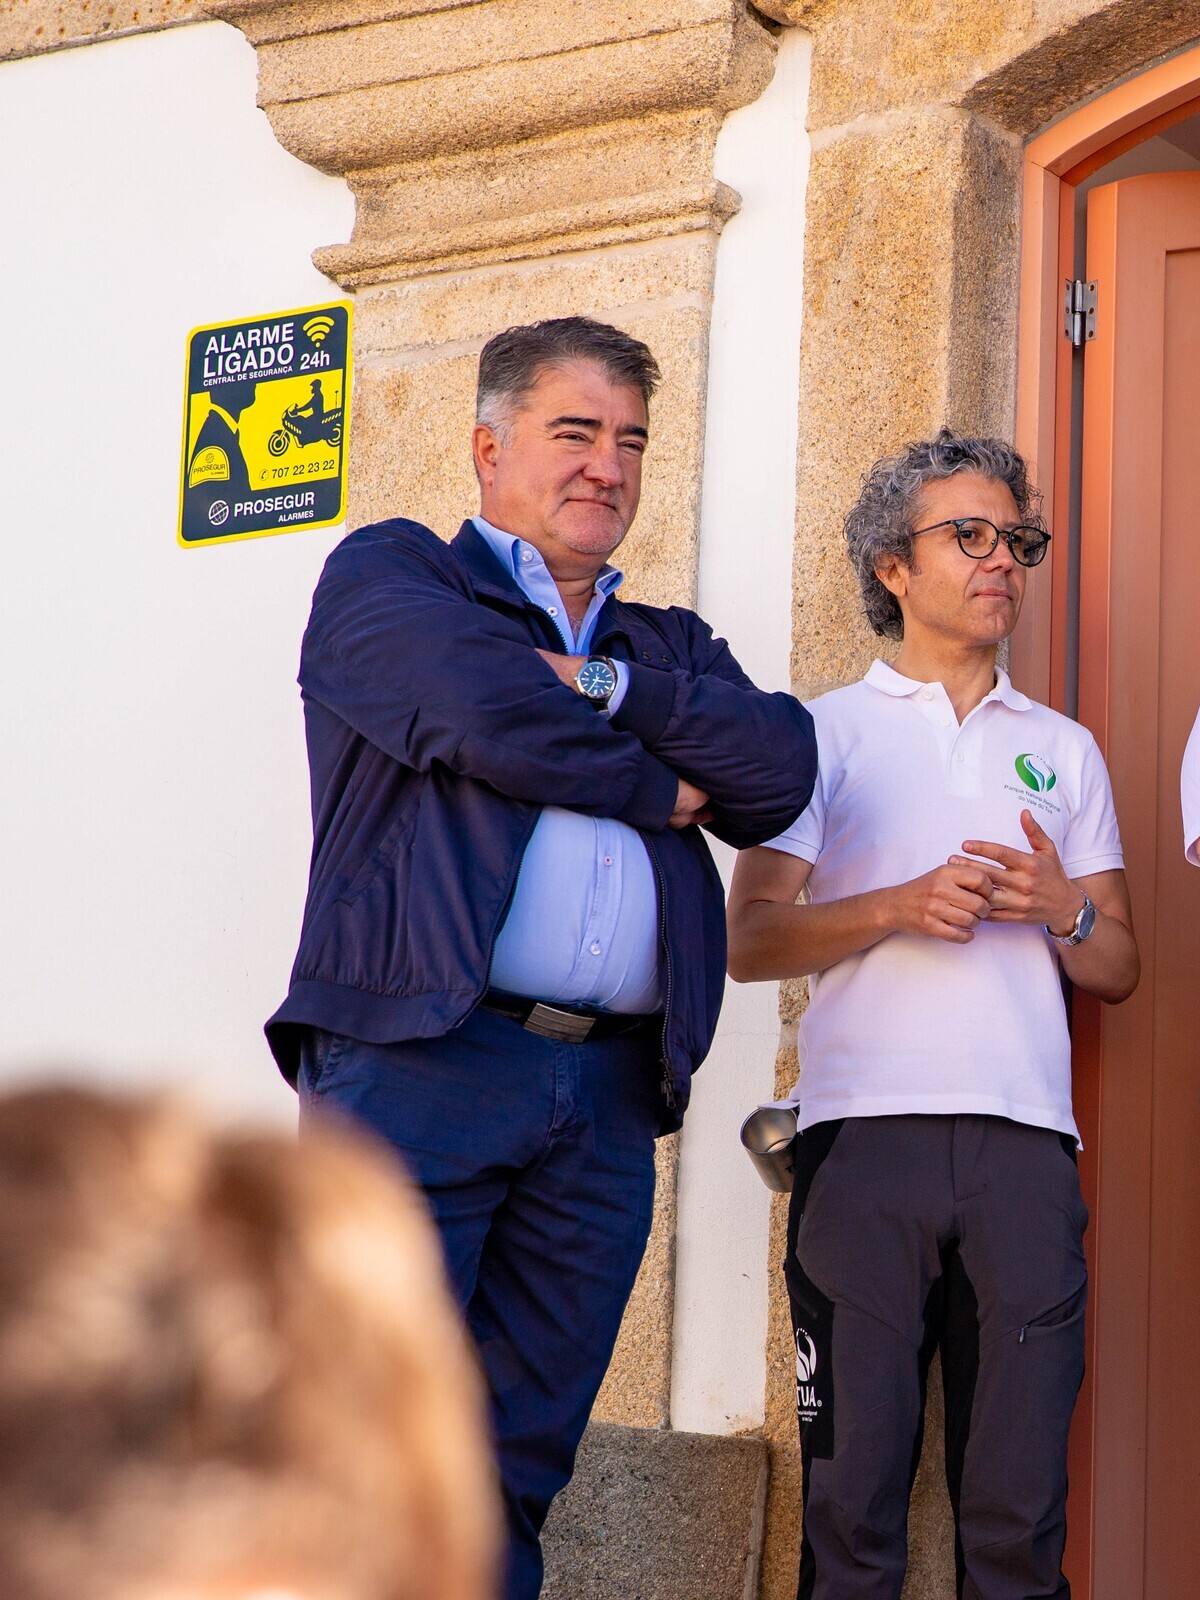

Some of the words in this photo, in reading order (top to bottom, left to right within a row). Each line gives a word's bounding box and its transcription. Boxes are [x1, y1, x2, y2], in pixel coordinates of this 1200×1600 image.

[205, 322, 294, 355] ALARME
[203, 343, 294, 378] LIGADO
[300, 350, 330, 370] 24h
[203, 375, 236, 387] CENTRAL
[237, 372, 248, 382] DE
[249, 366, 293, 380] SEGURANÇA
[194, 464, 225, 474] PROSEGUR
[272, 467, 289, 479] 707
[293, 464, 304, 476] 22
[308, 462, 319, 473] 23
[323, 459, 335, 470] 22
[234, 492, 315, 517] PROSEGUR
[278, 510, 314, 523] ALARMES
